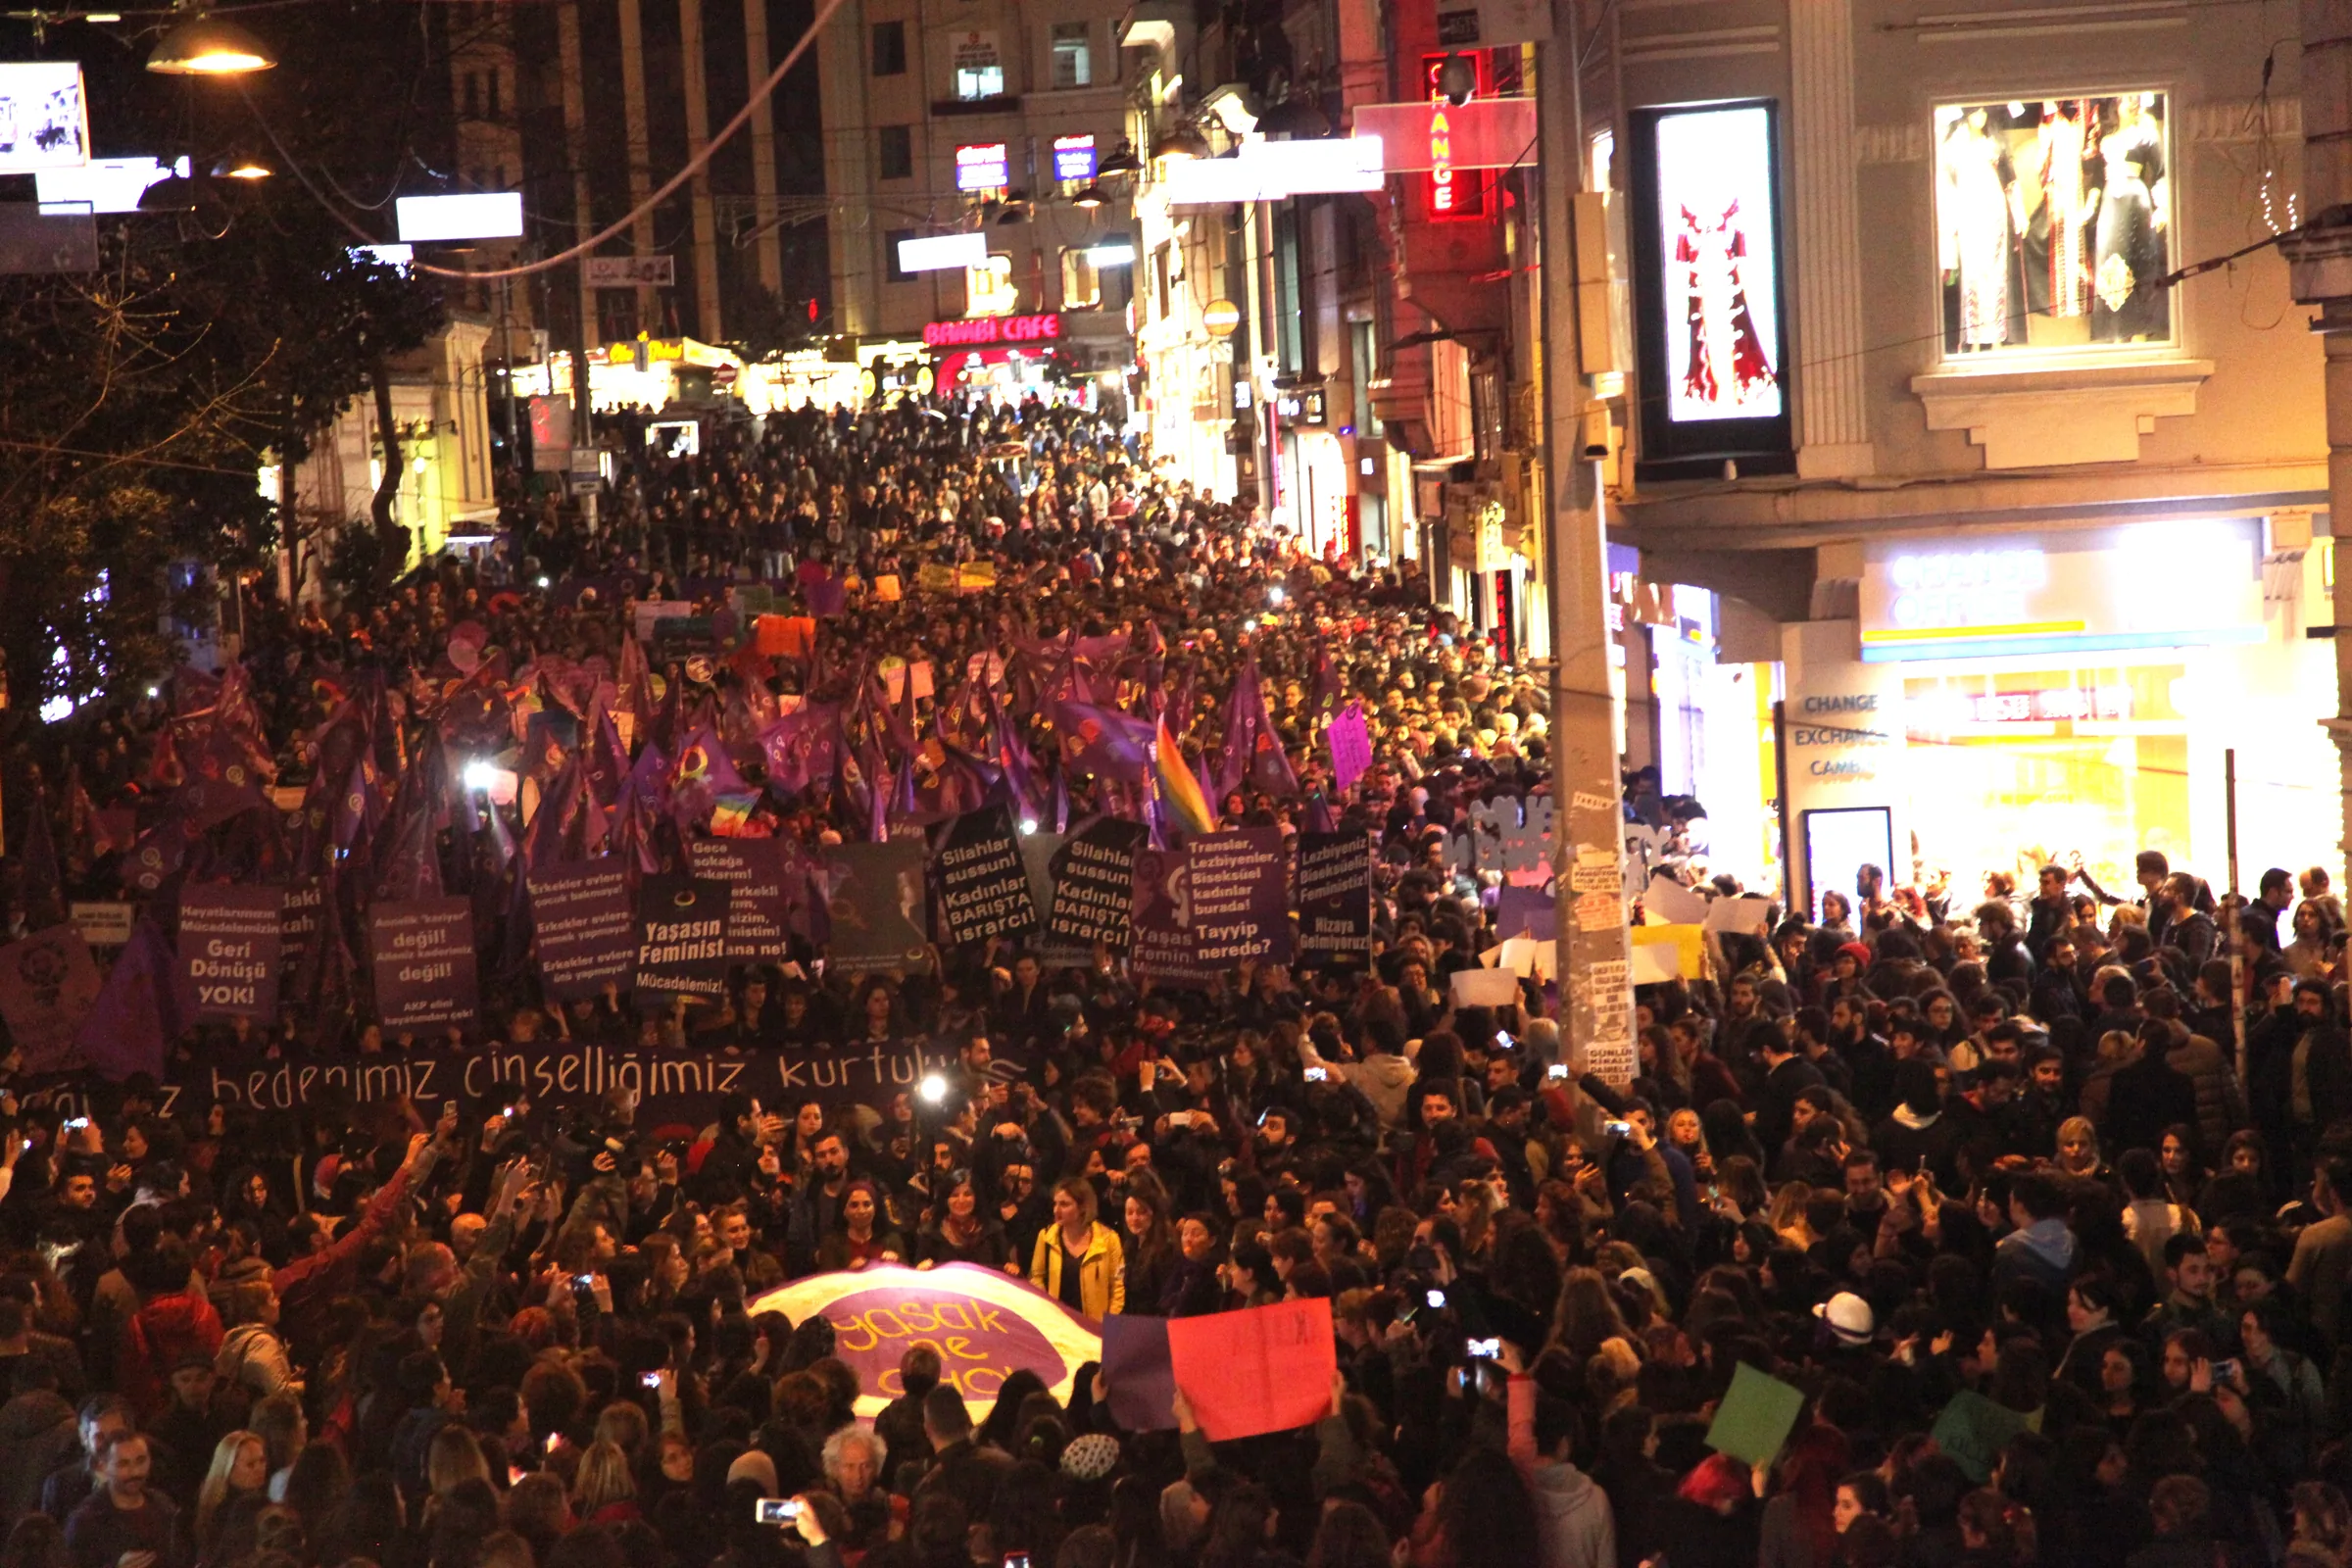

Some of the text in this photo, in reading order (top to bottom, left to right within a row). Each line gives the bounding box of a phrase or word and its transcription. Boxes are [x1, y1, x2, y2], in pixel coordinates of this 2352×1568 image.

[1003, 314, 1058, 340] CAFE
[1892, 550, 2043, 587] CHANGE
[1805, 694, 1879, 712] CHANGE
[1795, 728, 1884, 746] EXCHA
[942, 838, 1010, 866] Silahlar
[1188, 838, 1253, 854] Translar,
[946, 852, 1017, 885] sussun!
[1190, 851, 1279, 869] Lezbiyenler,
[1191, 866, 1261, 885] Biseksüel
[534, 880, 582, 894] rkekler
[946, 876, 1027, 909] Kadınlar
[1193, 884, 1252, 901] kadınlar
[950, 893, 1032, 926] BARIŞTA
[1054, 898, 1130, 928] BARIŞTA
[1194, 899, 1250, 915] burada!
[393, 929, 446, 949] değil!
[646, 919, 721, 943] Yaşasın
[1134, 924, 1194, 948] Yaşas
[1196, 921, 1258, 942] Tayyip
[208, 939, 251, 957] Geri
[639, 938, 724, 965] Feminist
[1133, 944, 1195, 963] Femin
[1199, 939, 1272, 959] nerede?
[190, 958, 266, 983] Dönüşü
[399, 962, 452, 983] değil!
[636, 972, 723, 994] Mücadelemiz!
[199, 986, 255, 1004] YOK!
[832, 1299, 1008, 1351] yasak
[908, 1336, 988, 1361] ne
